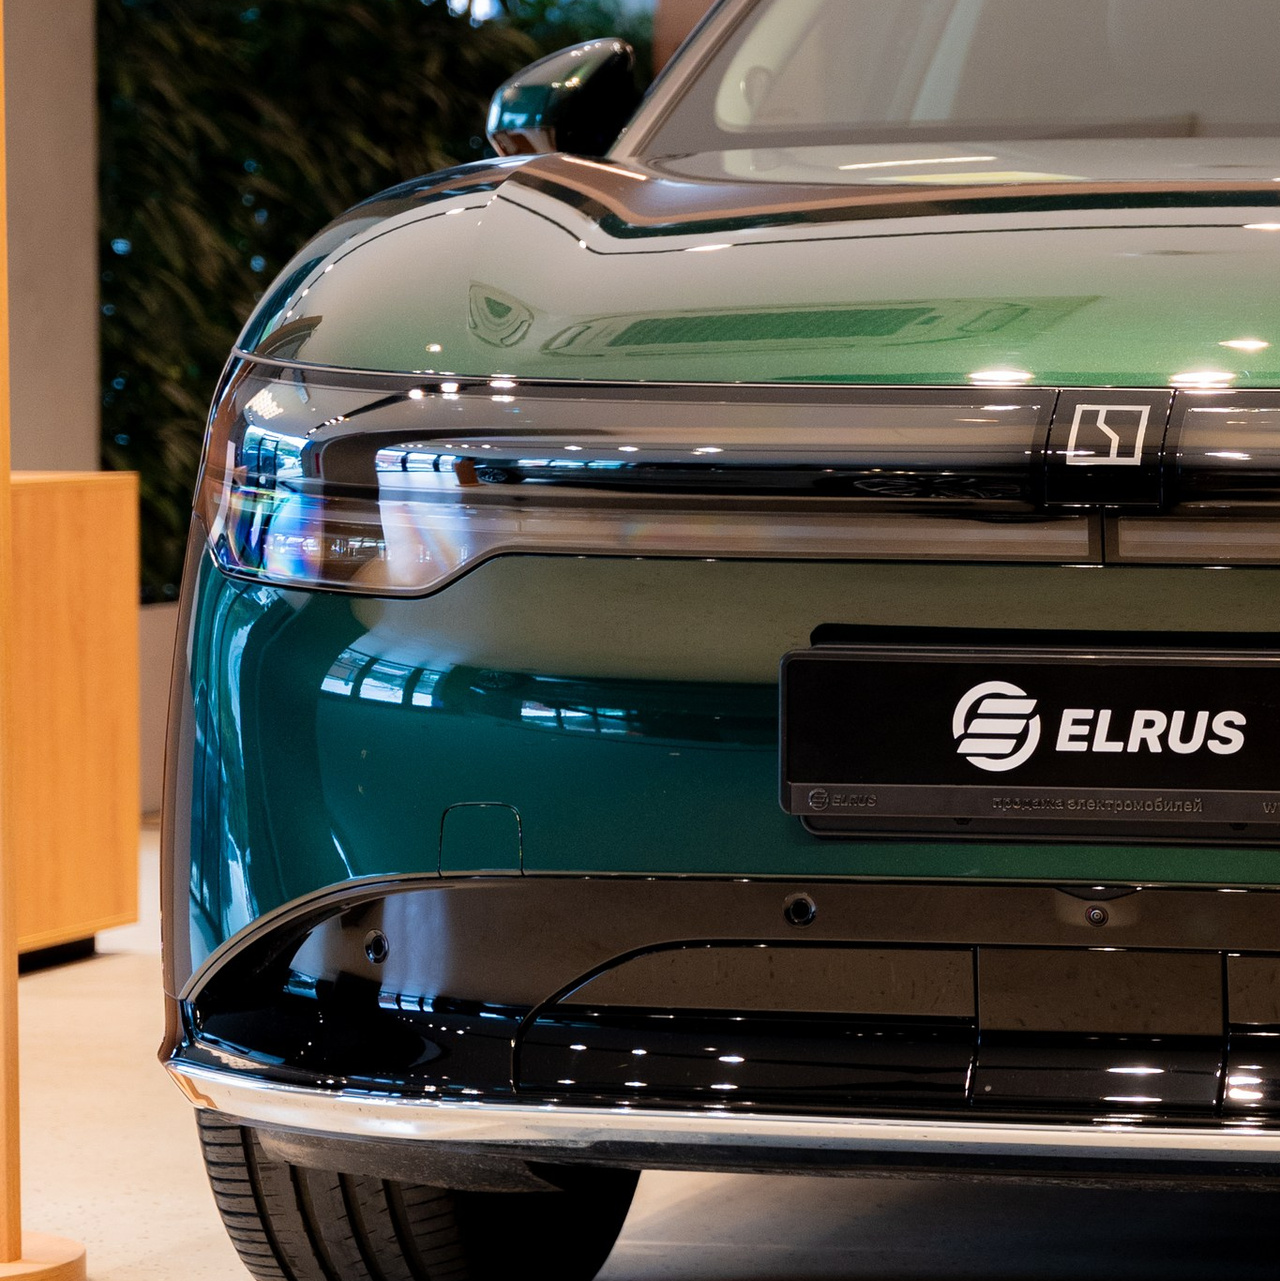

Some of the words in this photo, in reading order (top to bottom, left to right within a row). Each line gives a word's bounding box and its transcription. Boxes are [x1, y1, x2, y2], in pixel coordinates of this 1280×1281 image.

[1055, 708, 1247, 755] ELRUS
[831, 794, 878, 807] ELRUS
[992, 796, 1064, 813] продажа
[1067, 798, 1203, 814] электромобилей
